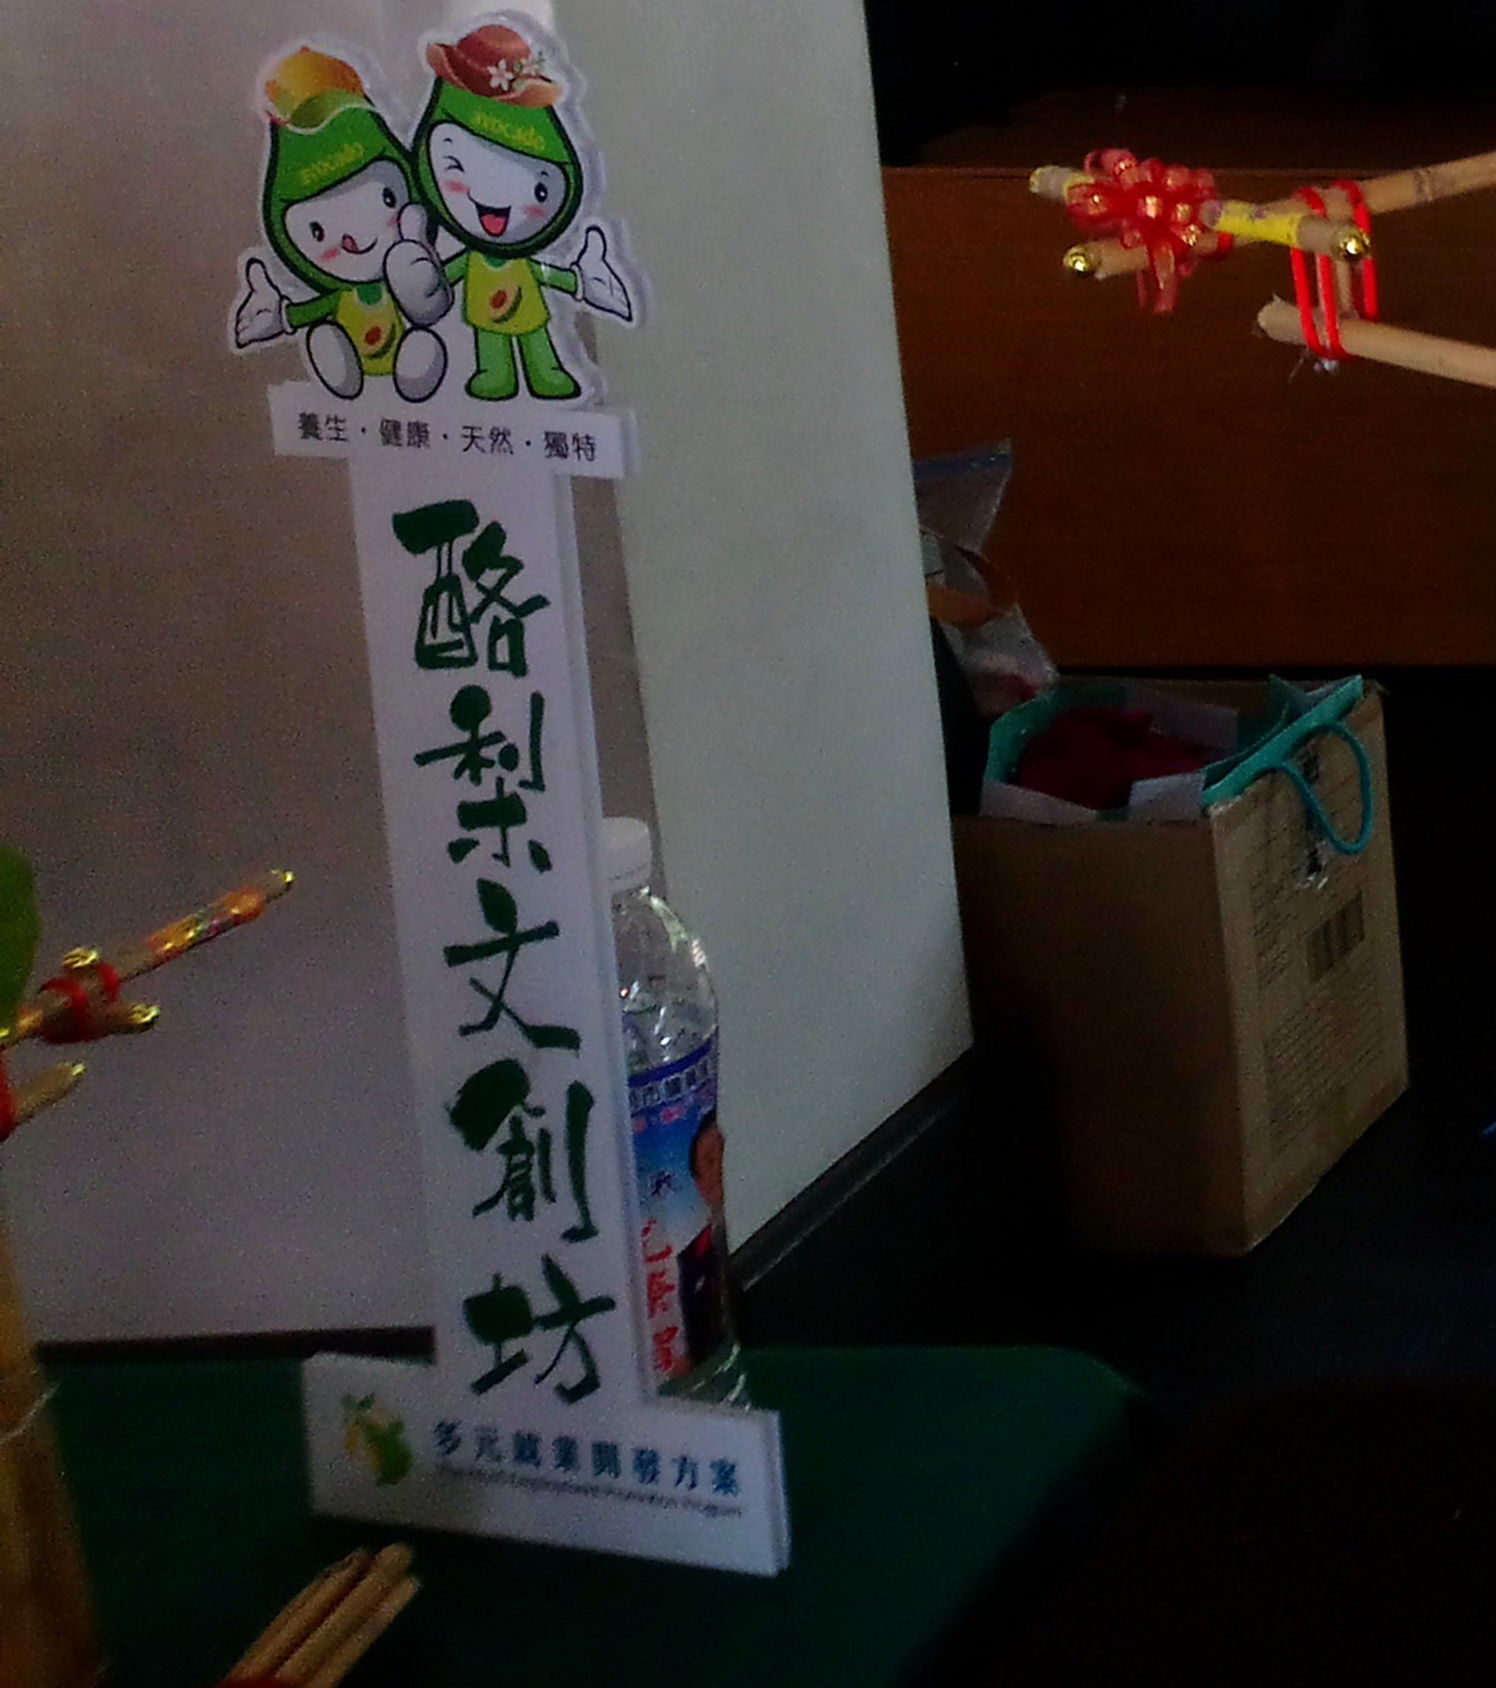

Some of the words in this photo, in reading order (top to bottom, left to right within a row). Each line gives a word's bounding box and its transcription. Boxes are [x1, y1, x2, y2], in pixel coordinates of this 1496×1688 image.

[391, 498, 616, 1402] 酪梨文創坊
